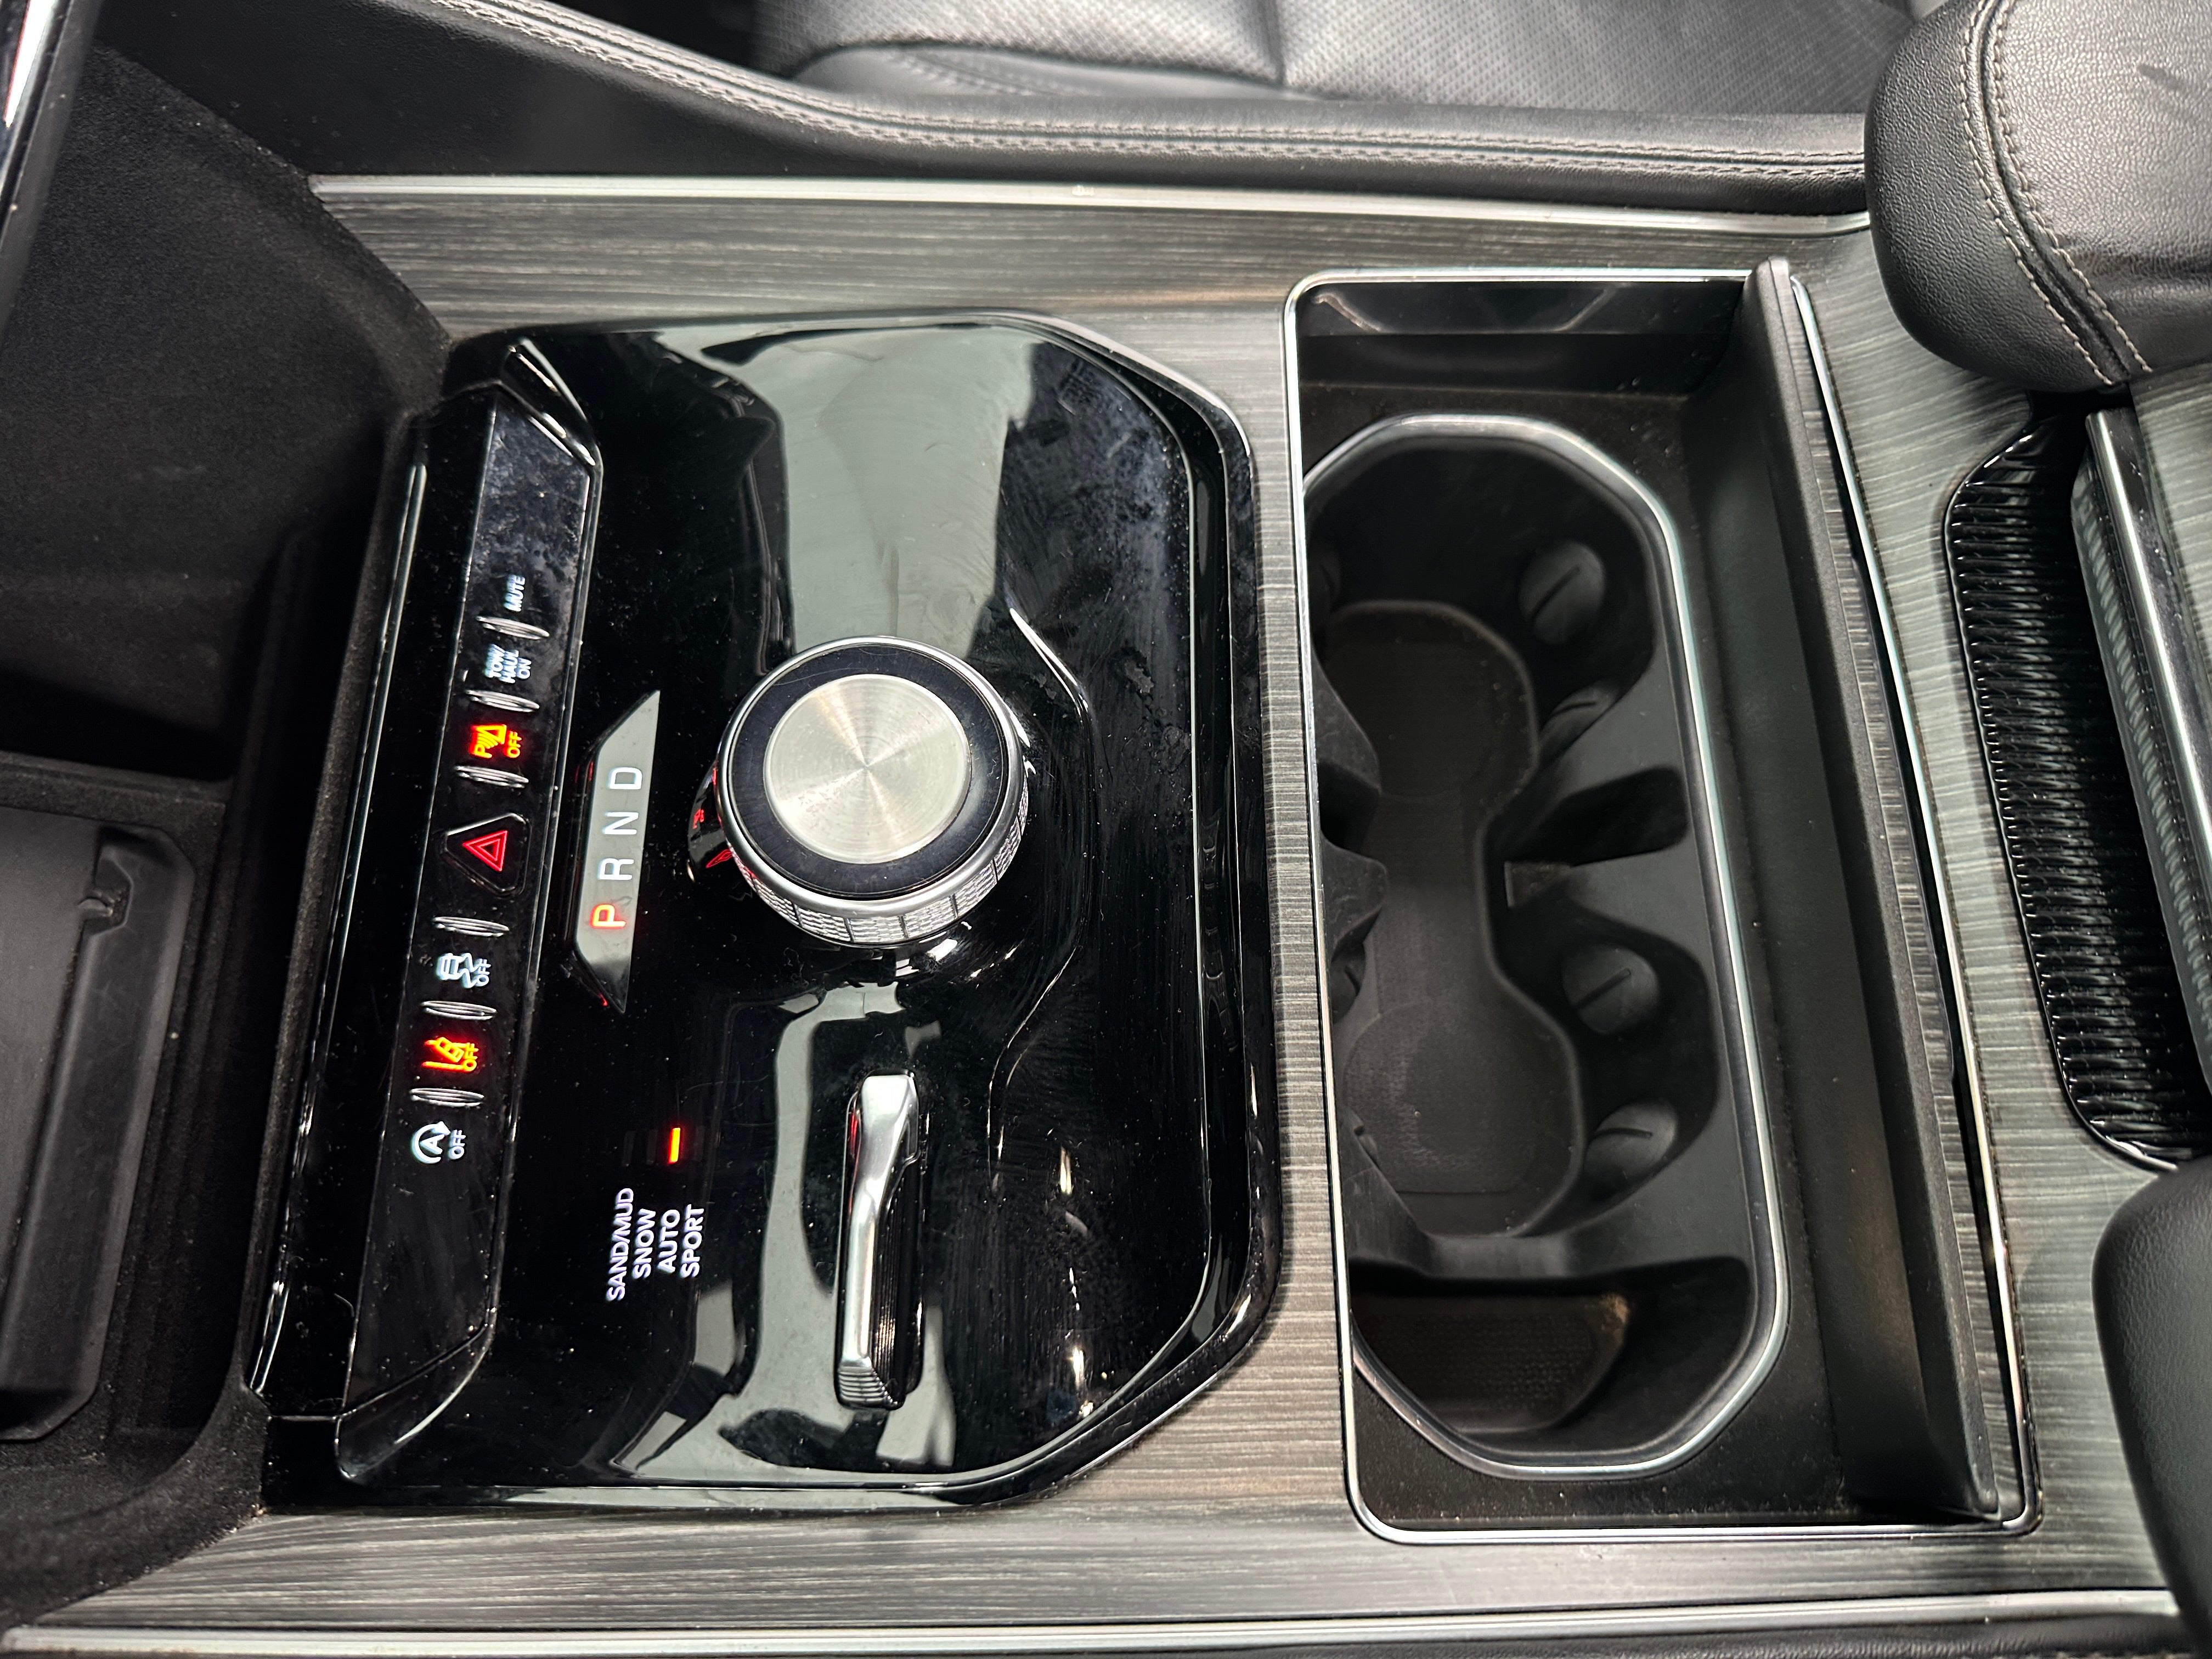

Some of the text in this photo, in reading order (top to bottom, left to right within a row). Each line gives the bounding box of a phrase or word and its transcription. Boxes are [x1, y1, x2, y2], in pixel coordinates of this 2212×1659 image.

[504, 574, 525, 612] MUTE
[498, 650, 519, 684] HAUL
[515, 657, 532, 680] ON
[504, 731, 522, 759] OFF
[590, 767, 643, 929] P R N D
[475, 958, 491, 987] OFF
[462, 1043, 479, 1072] OFF
[448, 1129, 466, 1160] OFF
[606, 1187, 634, 1302] SAND/MUD
[632, 1208, 656, 1280] SNOW
[657, 1209, 681, 1274] AUTO
[680, 1204, 704, 1279] SPORT
